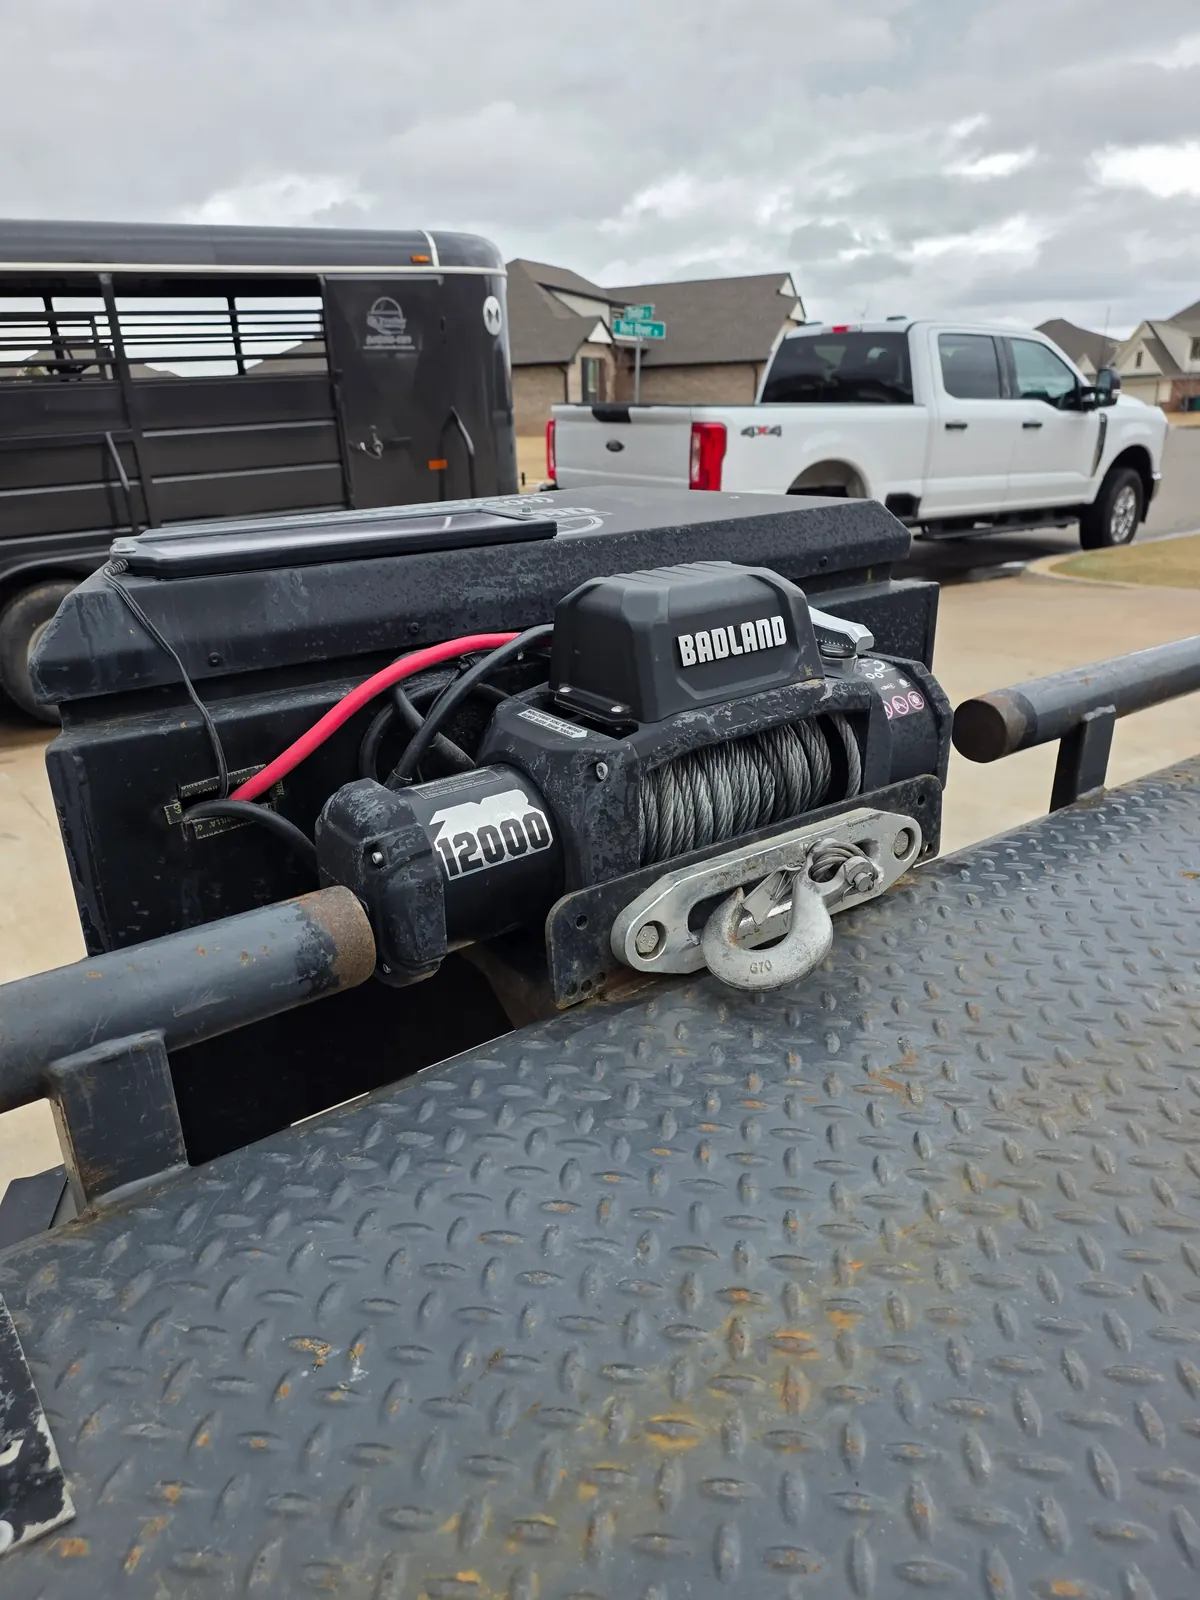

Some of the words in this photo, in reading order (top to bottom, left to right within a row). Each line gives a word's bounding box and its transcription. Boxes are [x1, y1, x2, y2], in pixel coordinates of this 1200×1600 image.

[677, 615, 788, 667] BADLAND
[436, 811, 551, 877] 12000
[749, 959, 773, 975] G70
